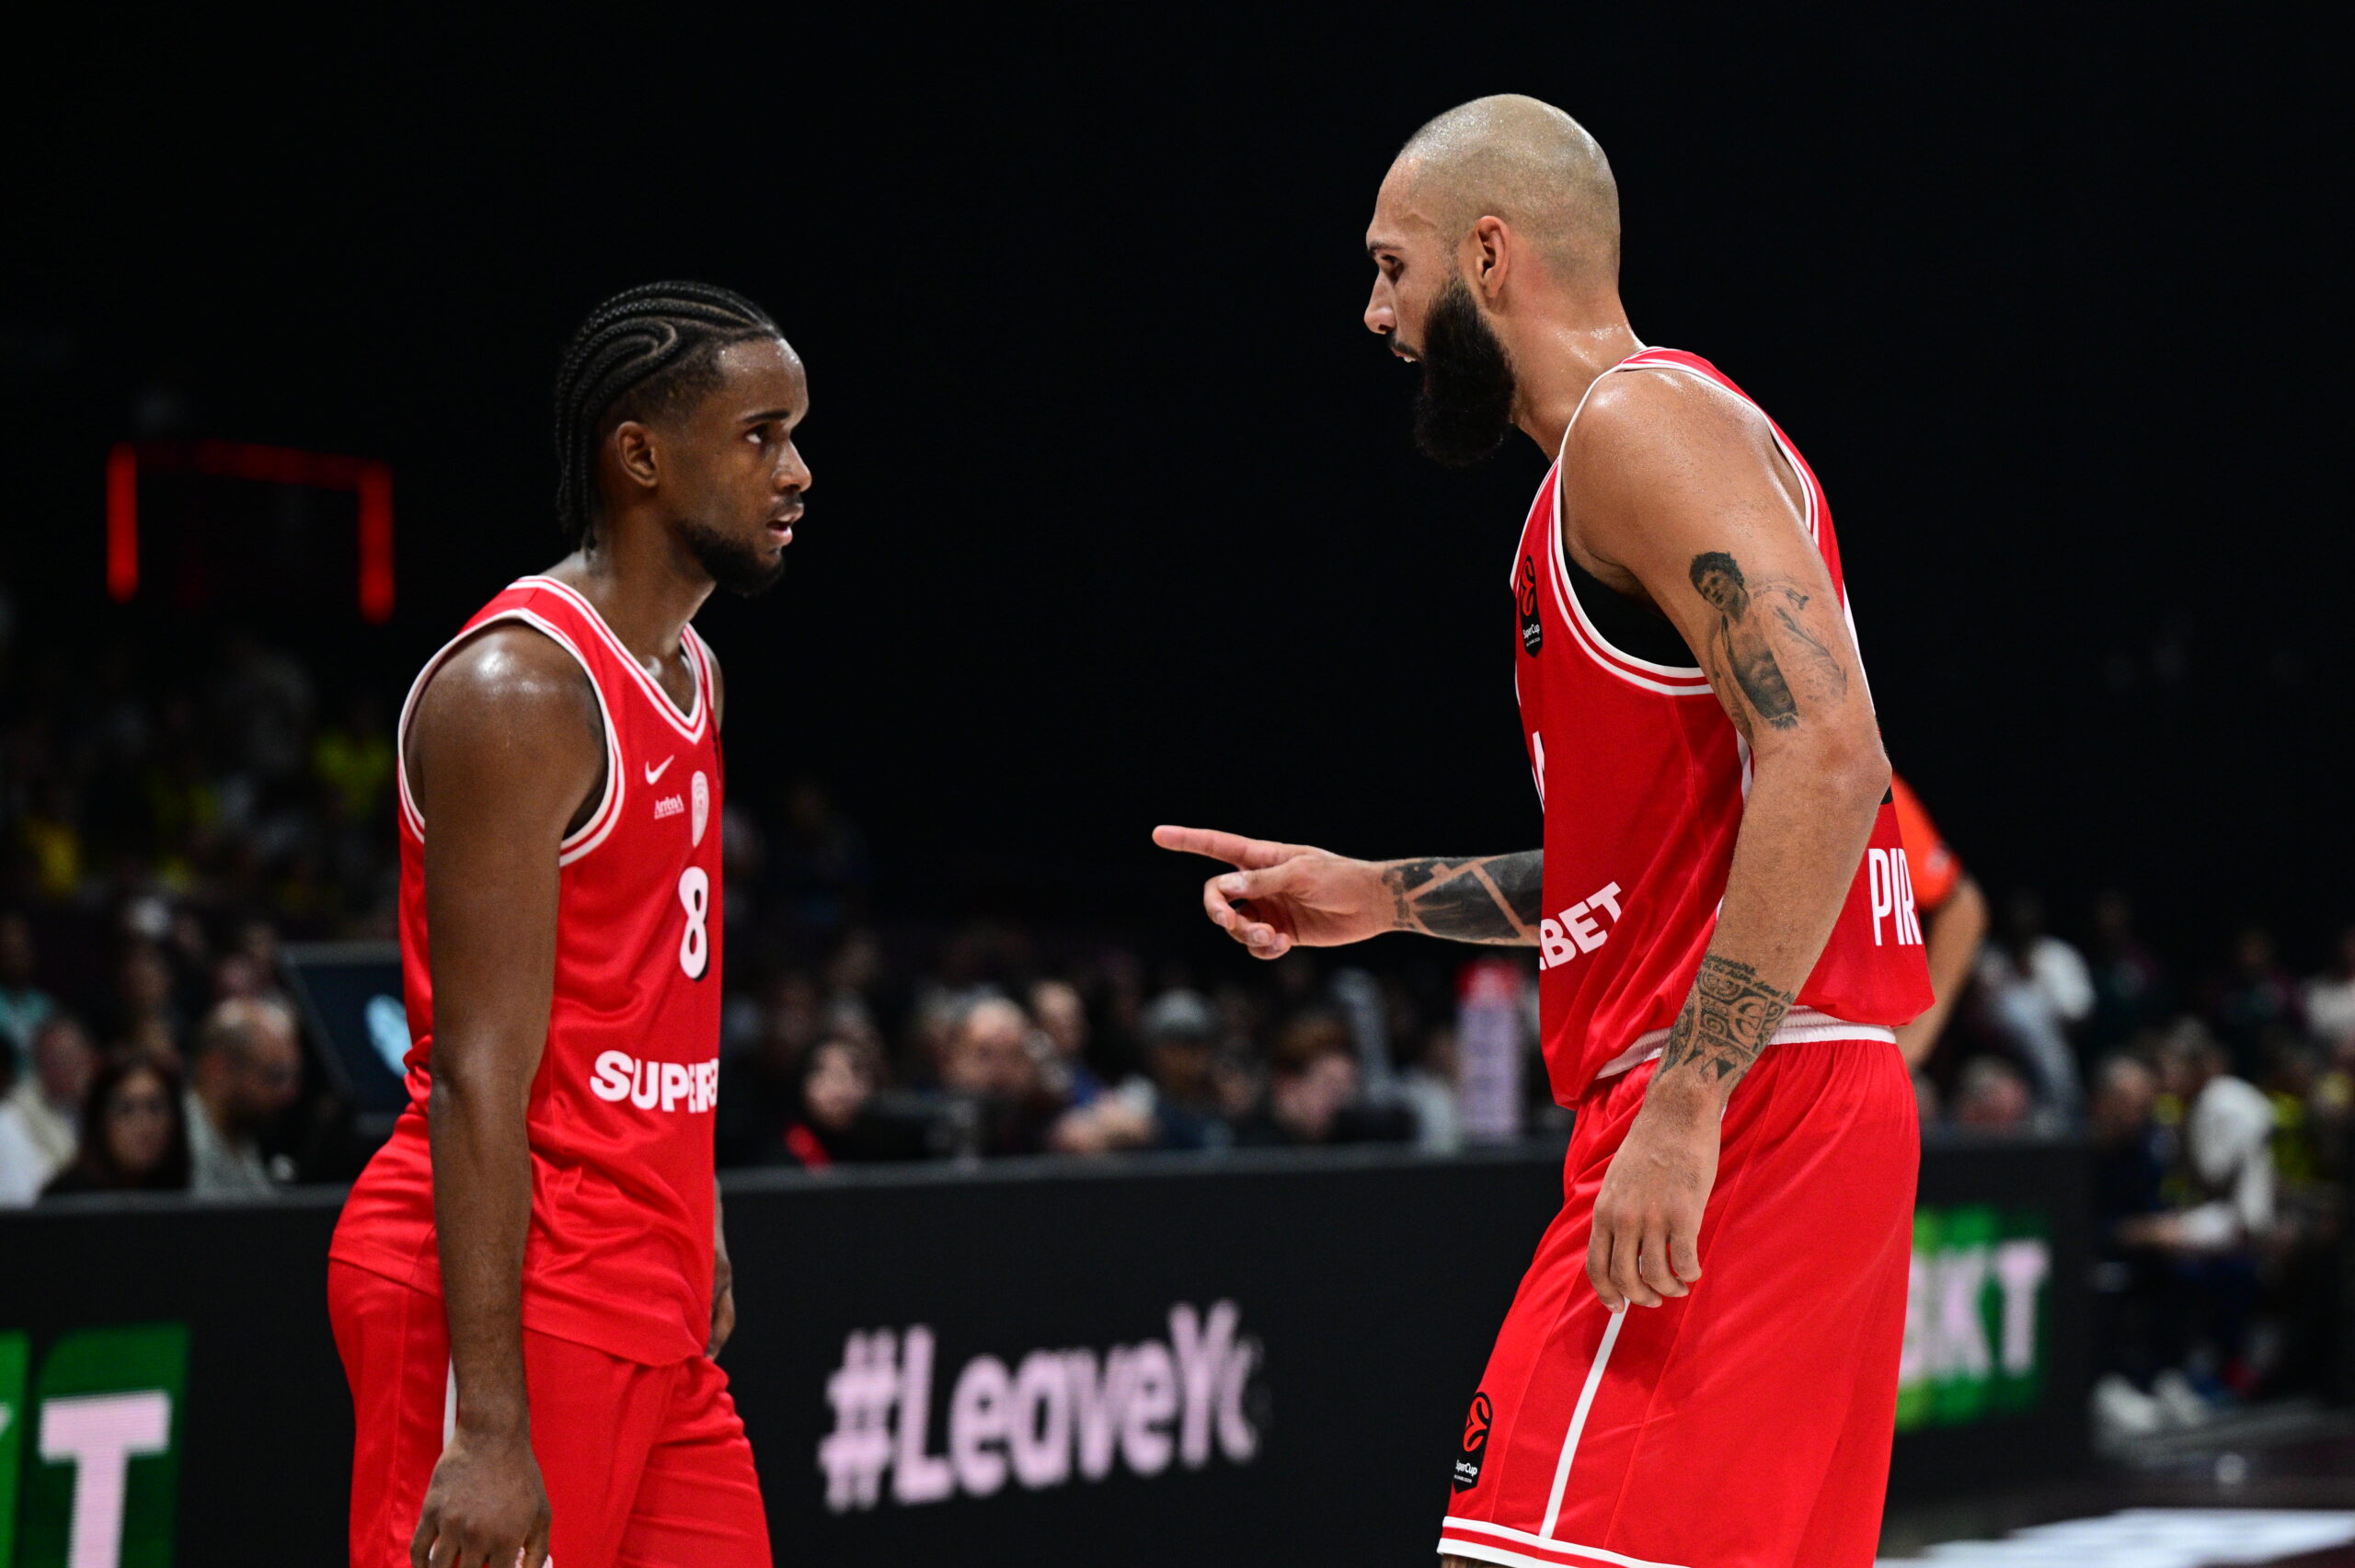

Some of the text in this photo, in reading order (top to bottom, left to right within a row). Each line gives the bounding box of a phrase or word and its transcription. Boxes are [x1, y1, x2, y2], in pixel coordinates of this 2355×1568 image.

[679, 865, 708, 981] 8
[1539, 880, 1622, 971] BET
[1868, 847, 1923, 946] PIR
[0, 1389, 172, 1568] T
